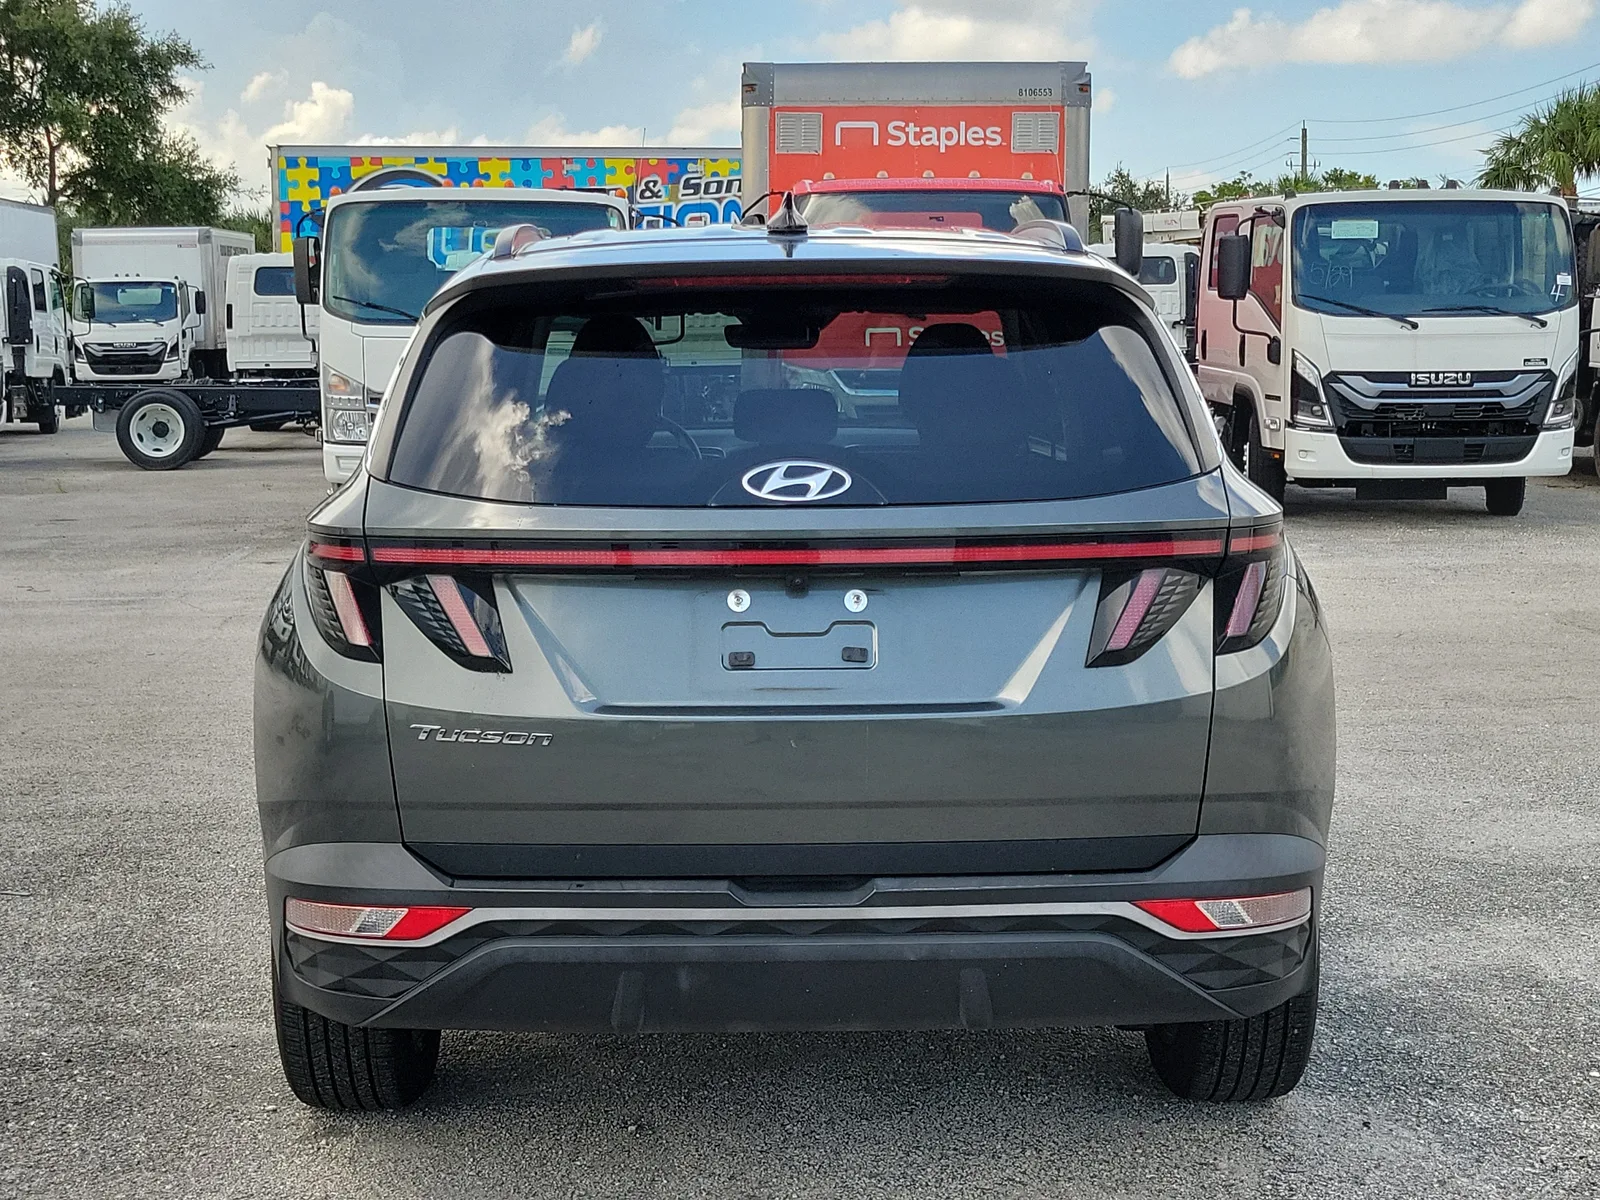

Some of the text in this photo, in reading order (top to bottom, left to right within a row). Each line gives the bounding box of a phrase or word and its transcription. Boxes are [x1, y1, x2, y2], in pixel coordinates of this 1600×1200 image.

[887, 120, 1002, 153] Staples
[639, 179, 663, 200] &
[1550, 284, 1565, 302] 4
[1410, 372, 1472, 386] ISUZU
